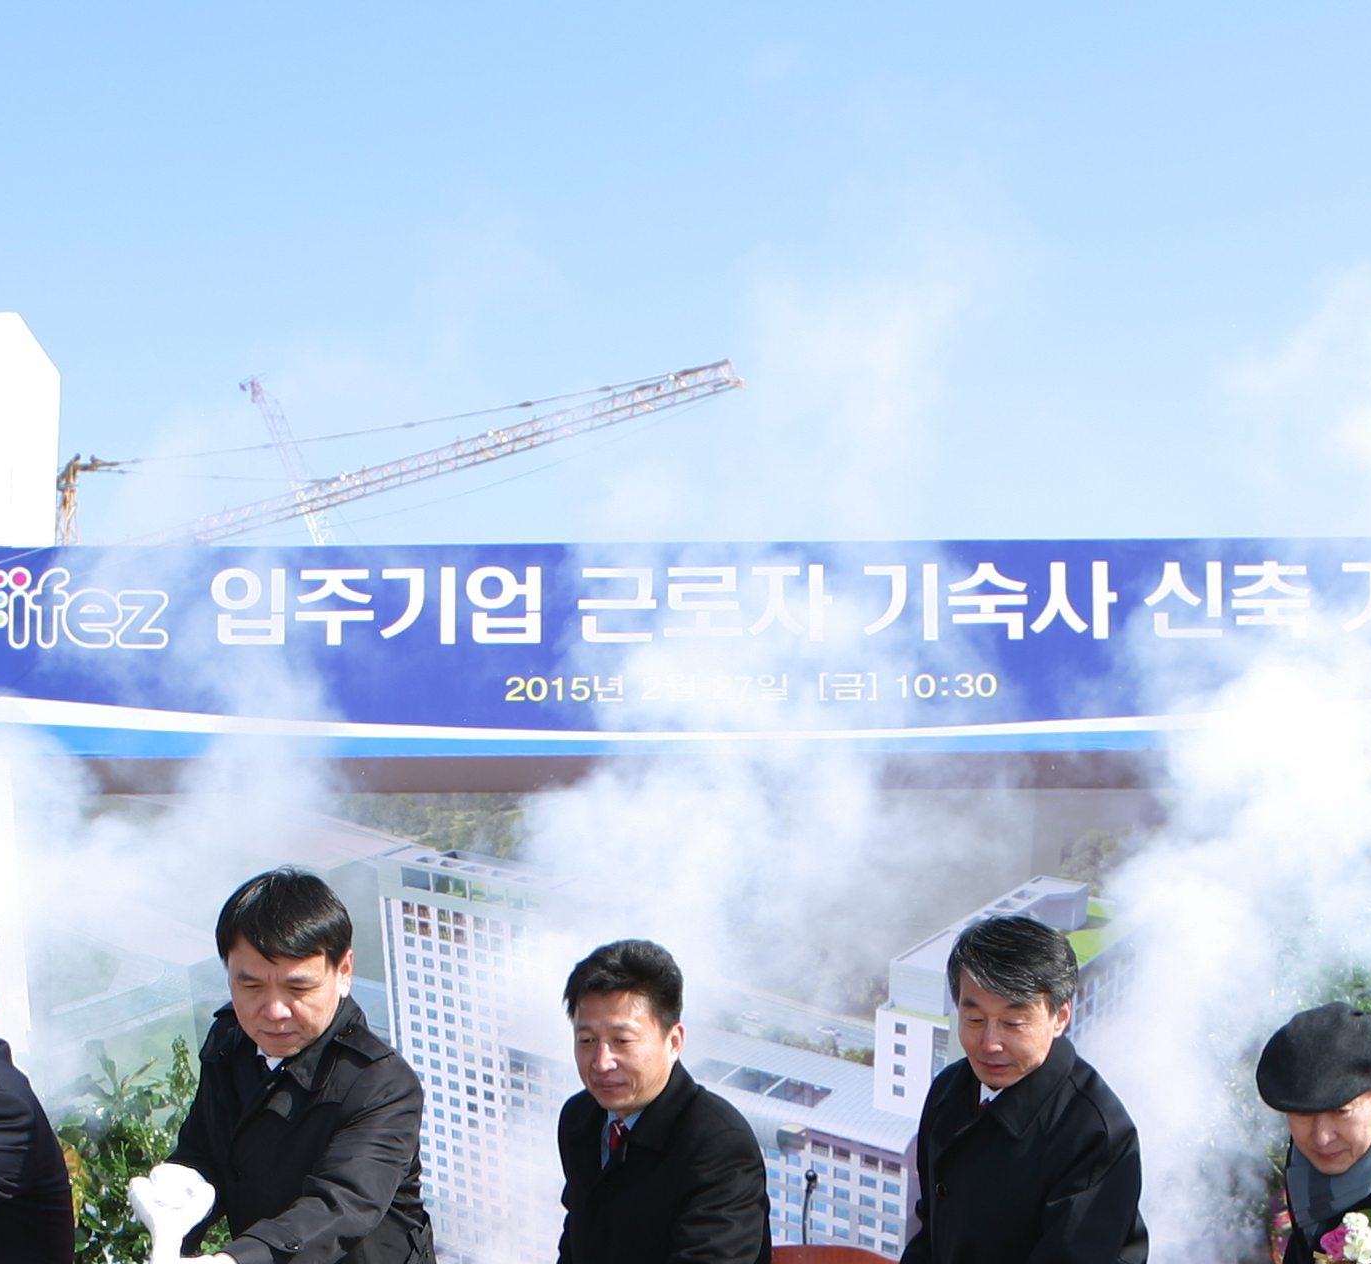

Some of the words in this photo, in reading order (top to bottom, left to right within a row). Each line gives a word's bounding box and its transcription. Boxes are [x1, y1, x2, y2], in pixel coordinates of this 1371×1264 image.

[7, 566, 169, 650] ifez
[210, 565, 542, 648] 입주기업
[576, 562, 833, 644] 근로자
[862, 560, 1119, 643] 기숙사
[1143, 560, 1311, 640] 신축
[504, 675, 624, 703] 2015년
[896, 672, 999, 700] 10:30
